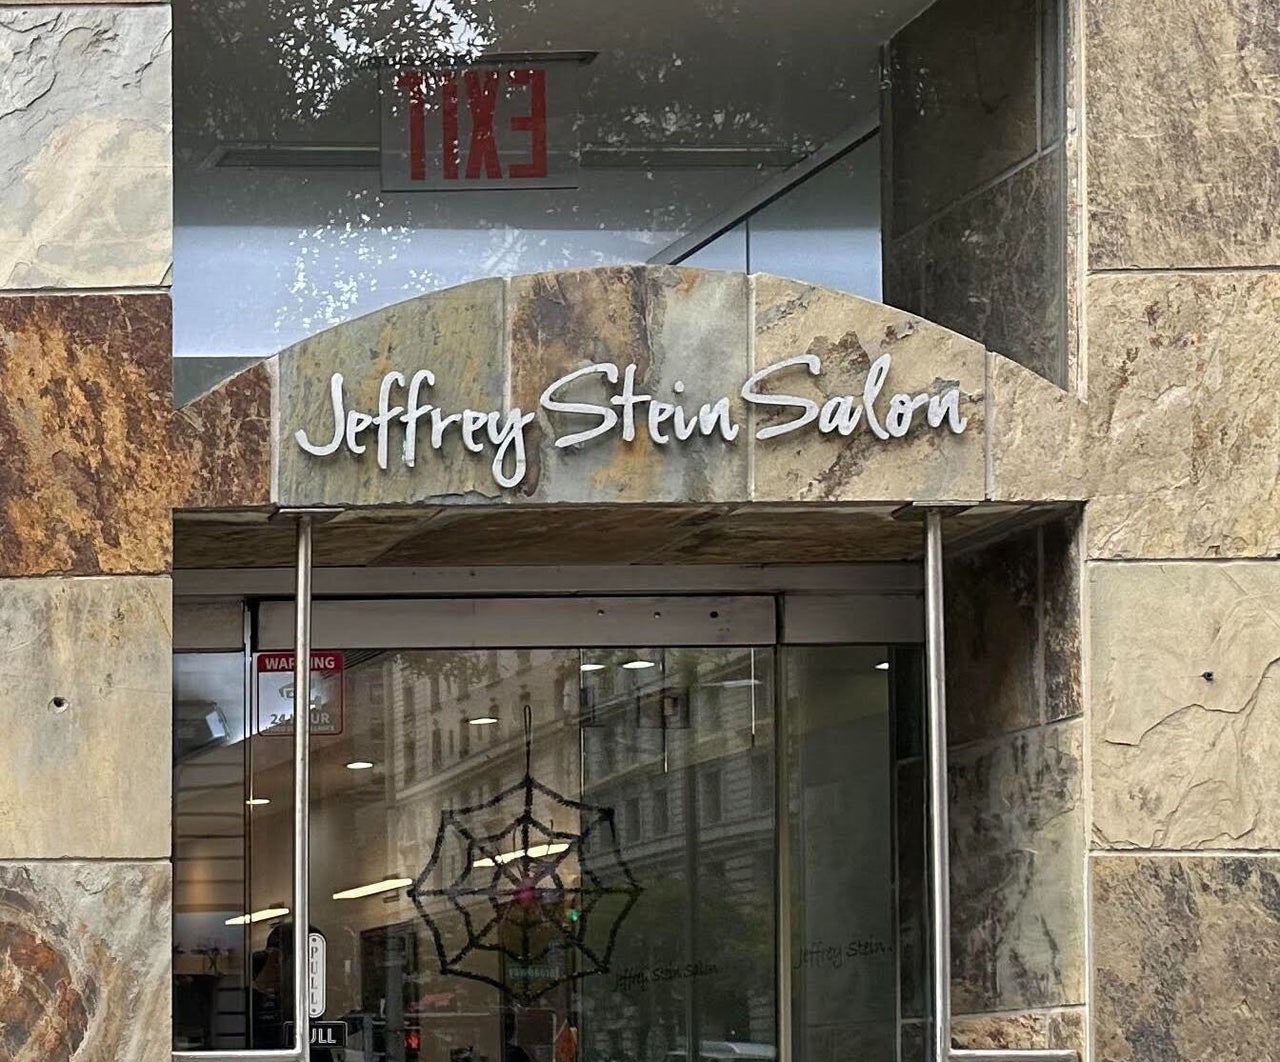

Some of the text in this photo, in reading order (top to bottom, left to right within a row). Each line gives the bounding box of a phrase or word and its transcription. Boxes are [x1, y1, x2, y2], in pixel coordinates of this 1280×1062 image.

[296, 352, 969, 488] Jeffrey Stein Salon
[265, 656, 336, 670] WARING
[309, 1028, 337, 1044] ULL
